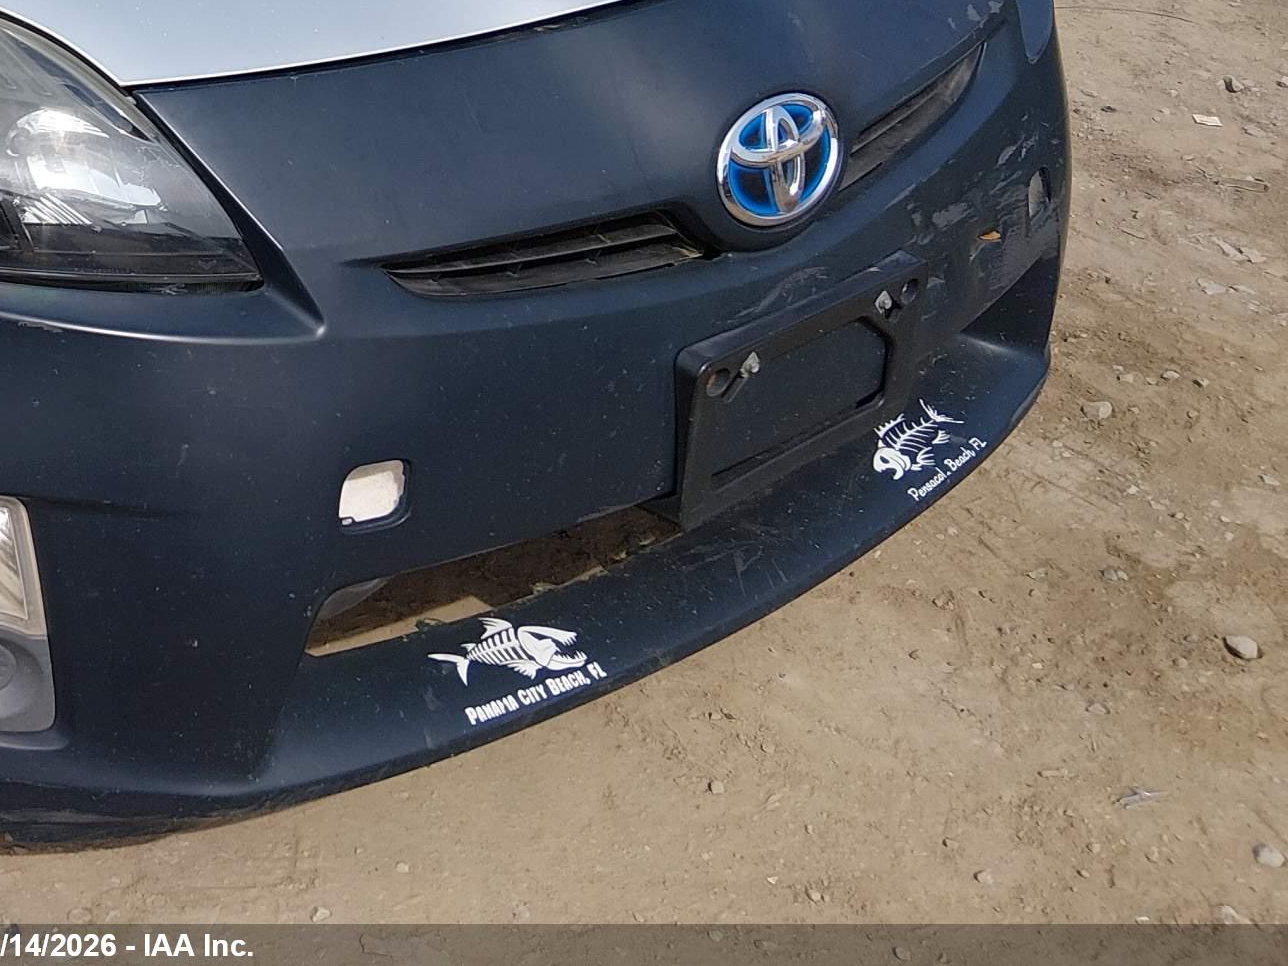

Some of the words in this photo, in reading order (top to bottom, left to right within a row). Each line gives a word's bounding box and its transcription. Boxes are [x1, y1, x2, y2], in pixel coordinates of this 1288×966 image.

[968, 437, 988, 451] FL
[465, 695, 520, 726] PANAMA
[517, 684, 549, 706] CITY
[545, 669, 592, 696] BEACH,
[587, 661, 608, 681] FL
